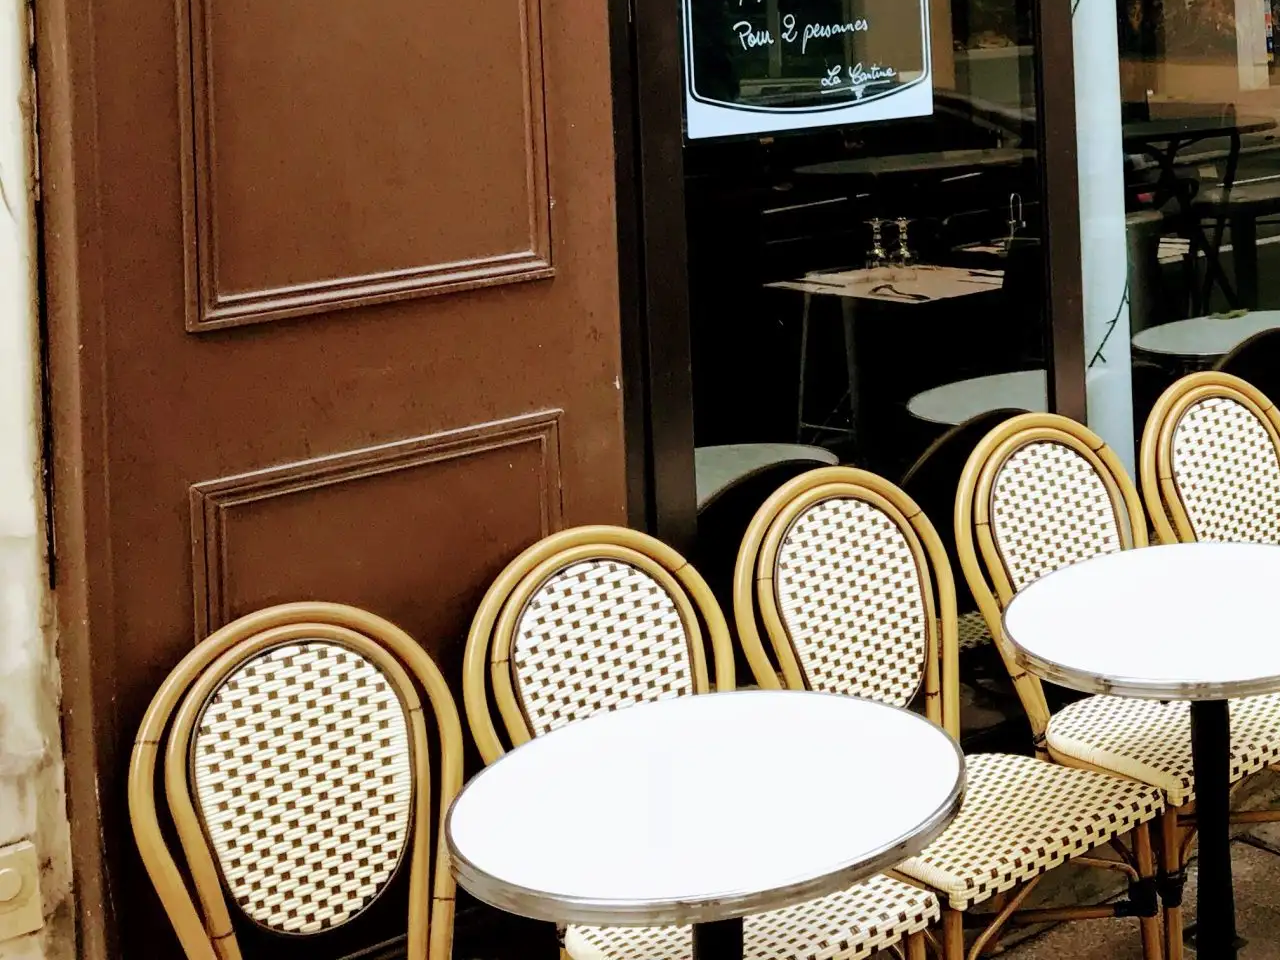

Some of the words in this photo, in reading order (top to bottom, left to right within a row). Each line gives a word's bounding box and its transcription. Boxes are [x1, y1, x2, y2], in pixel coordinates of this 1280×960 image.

[733, 21, 775, 51] Pour
[782, 14, 798, 43] 2
[802, 18, 868, 54] personnes
[821, 64, 842, 87] La
[848, 62, 897, 85] Cantine
